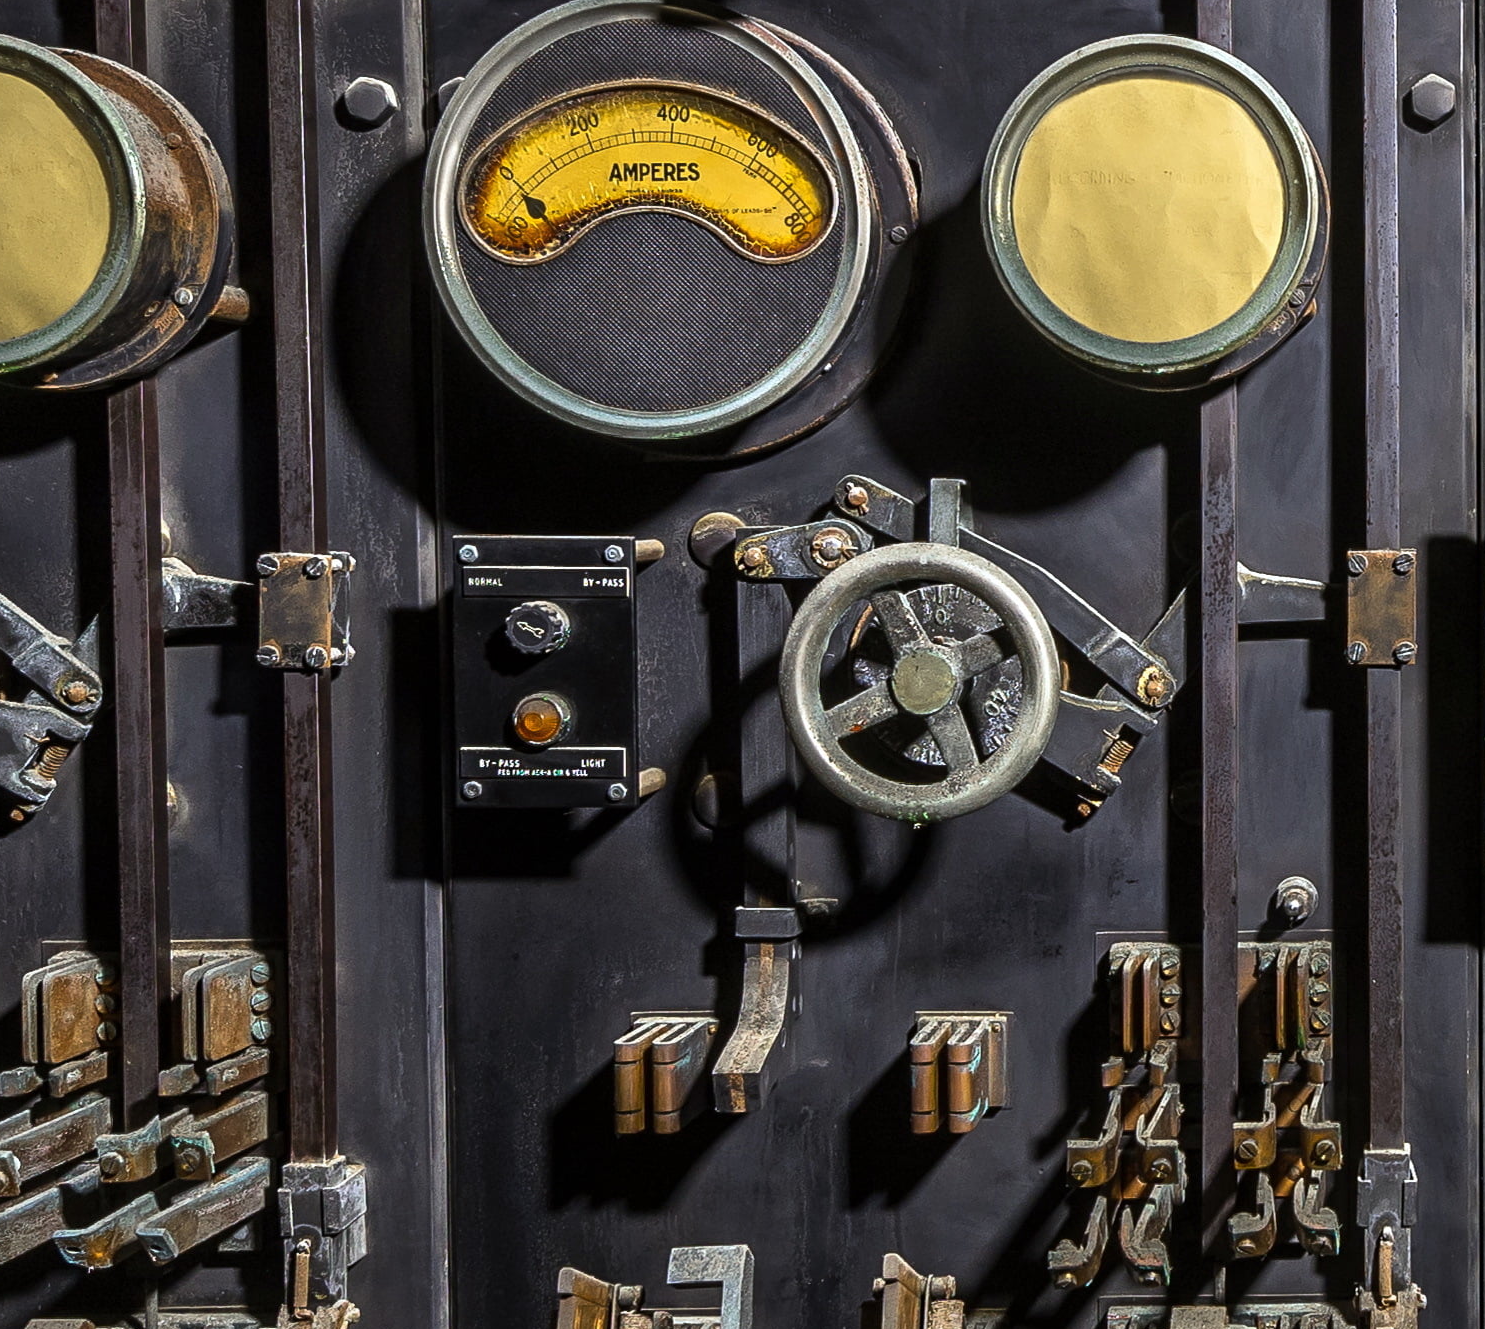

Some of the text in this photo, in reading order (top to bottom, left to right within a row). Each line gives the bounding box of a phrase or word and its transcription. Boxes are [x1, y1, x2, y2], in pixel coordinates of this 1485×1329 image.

[657, 105, 691, 123] 400
[567, 114, 599, 136] 200
[747, 130, 779, 159] 600
[498, 166, 514, 181] 0
[608, 163, 700, 183] AMPERES
[783, 214, 812, 241] 800
[468, 577, 625, 588] NORMAL BY-PASS
[934, 608, 948, 626] 0
[478, 758, 607, 768] BY-PASS LIGHT
